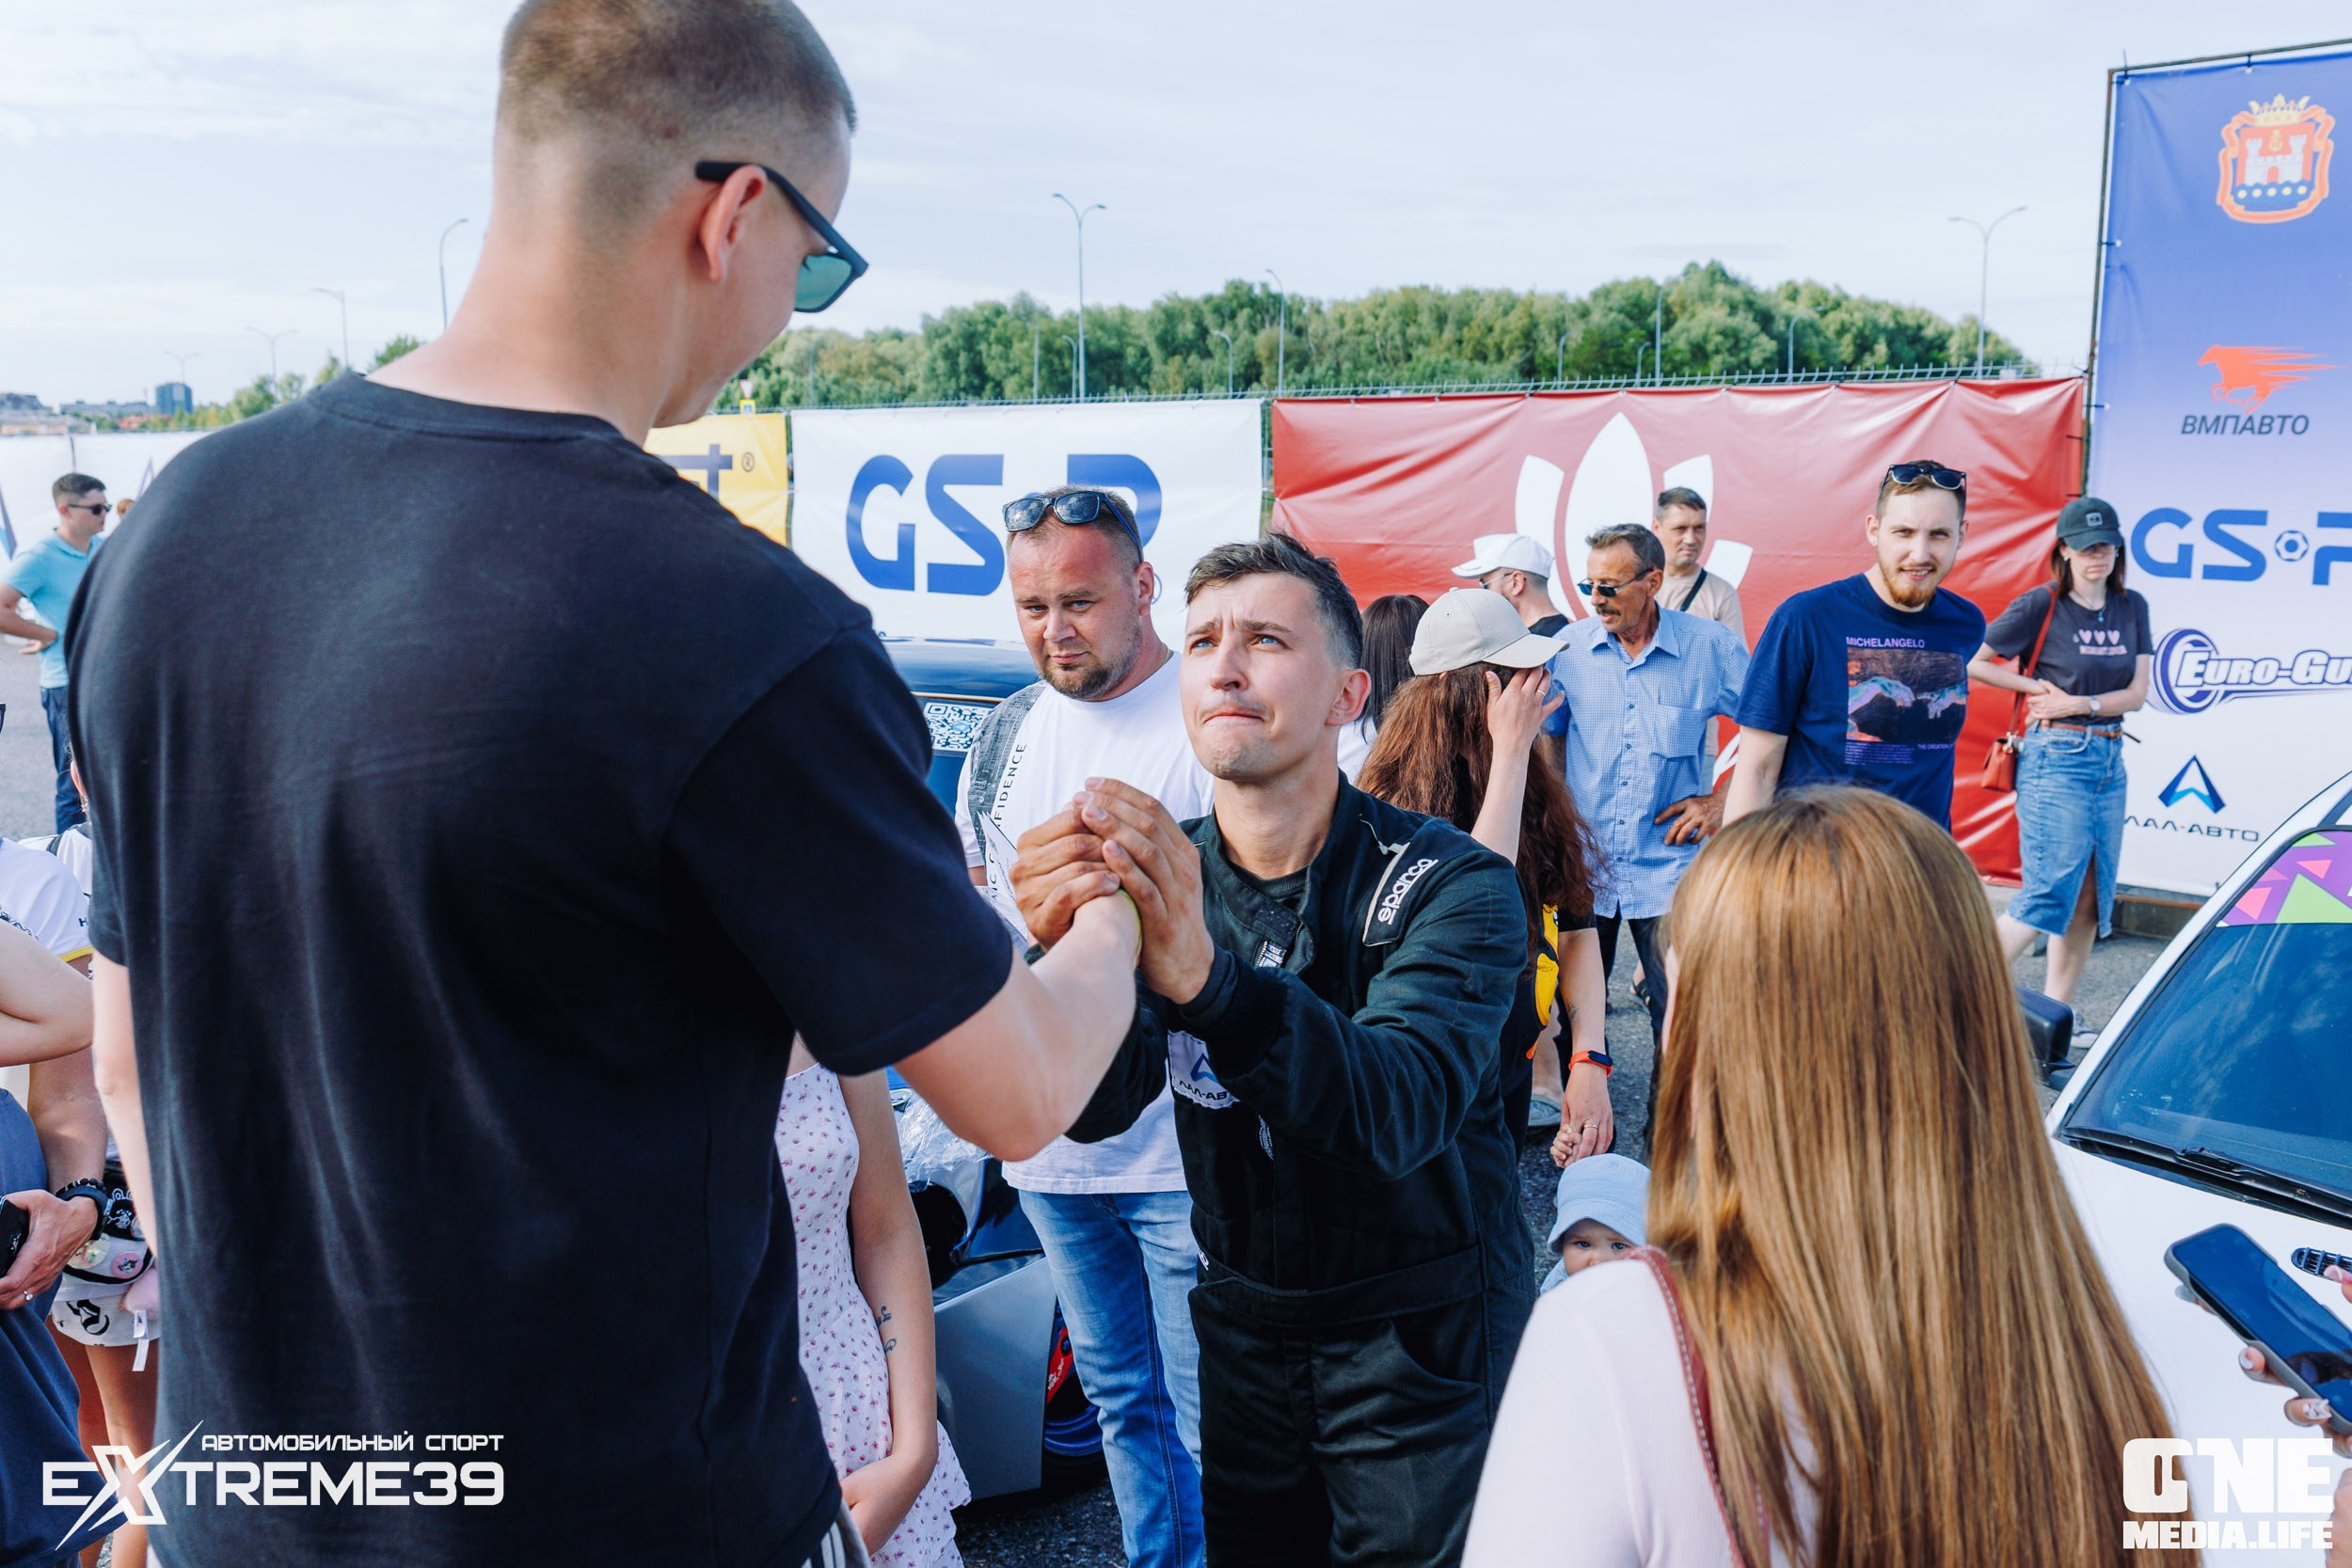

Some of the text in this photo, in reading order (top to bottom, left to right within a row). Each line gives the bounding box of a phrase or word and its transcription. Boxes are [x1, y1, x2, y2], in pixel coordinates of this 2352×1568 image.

[2181, 414, 2311, 436] ВМПАВТО
[1846, 636, 1926, 649] MICHELANGELO
[993, 743, 1027, 828] FIDENCE
[1377, 858, 1438, 925] sparco
